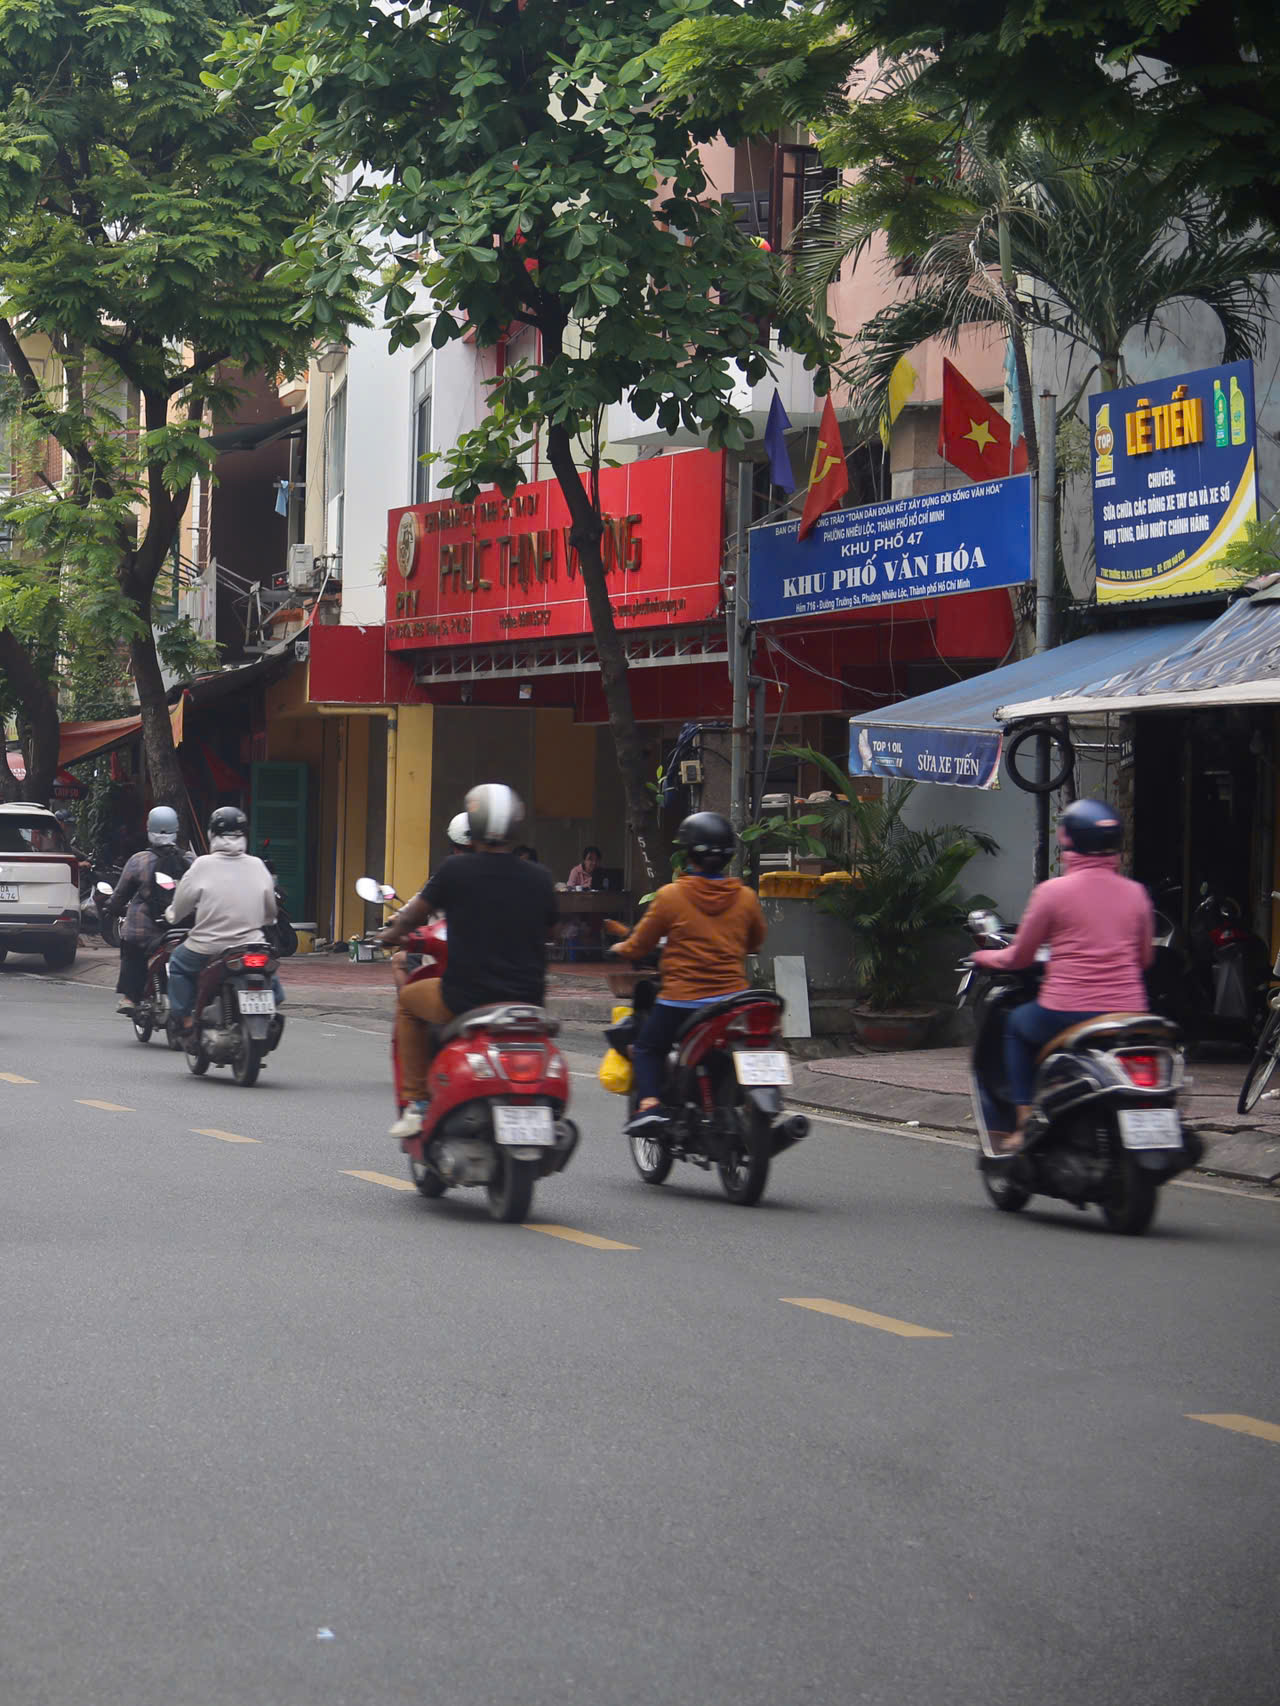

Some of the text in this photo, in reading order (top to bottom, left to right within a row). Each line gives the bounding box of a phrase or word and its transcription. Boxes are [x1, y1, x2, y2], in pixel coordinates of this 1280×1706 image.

[1125, 384, 1204, 457] LÊ TIẾN
[1096, 433, 1112, 449] TOP
[1166, 494, 1176, 511] XE
[1176, 492, 1188, 509] TAY
[1188, 490, 1199, 507] GA
[1209, 487, 1219, 504] XE
[1220, 481, 1231, 502] SỐ
[929, 509, 945, 523] MINH
[776, 526, 787, 536] BAN
[841, 530, 924, 558] KHU PHỐ 47
[783, 543, 986, 598] KHU PHỐ VĂN HÓA
[872, 740, 886, 752] TOP
[892, 741, 903, 753] OIL
[917, 749, 937, 772] SỬA
[938, 756, 952, 774] XE
[952, 752, 980, 776] TIẾN
